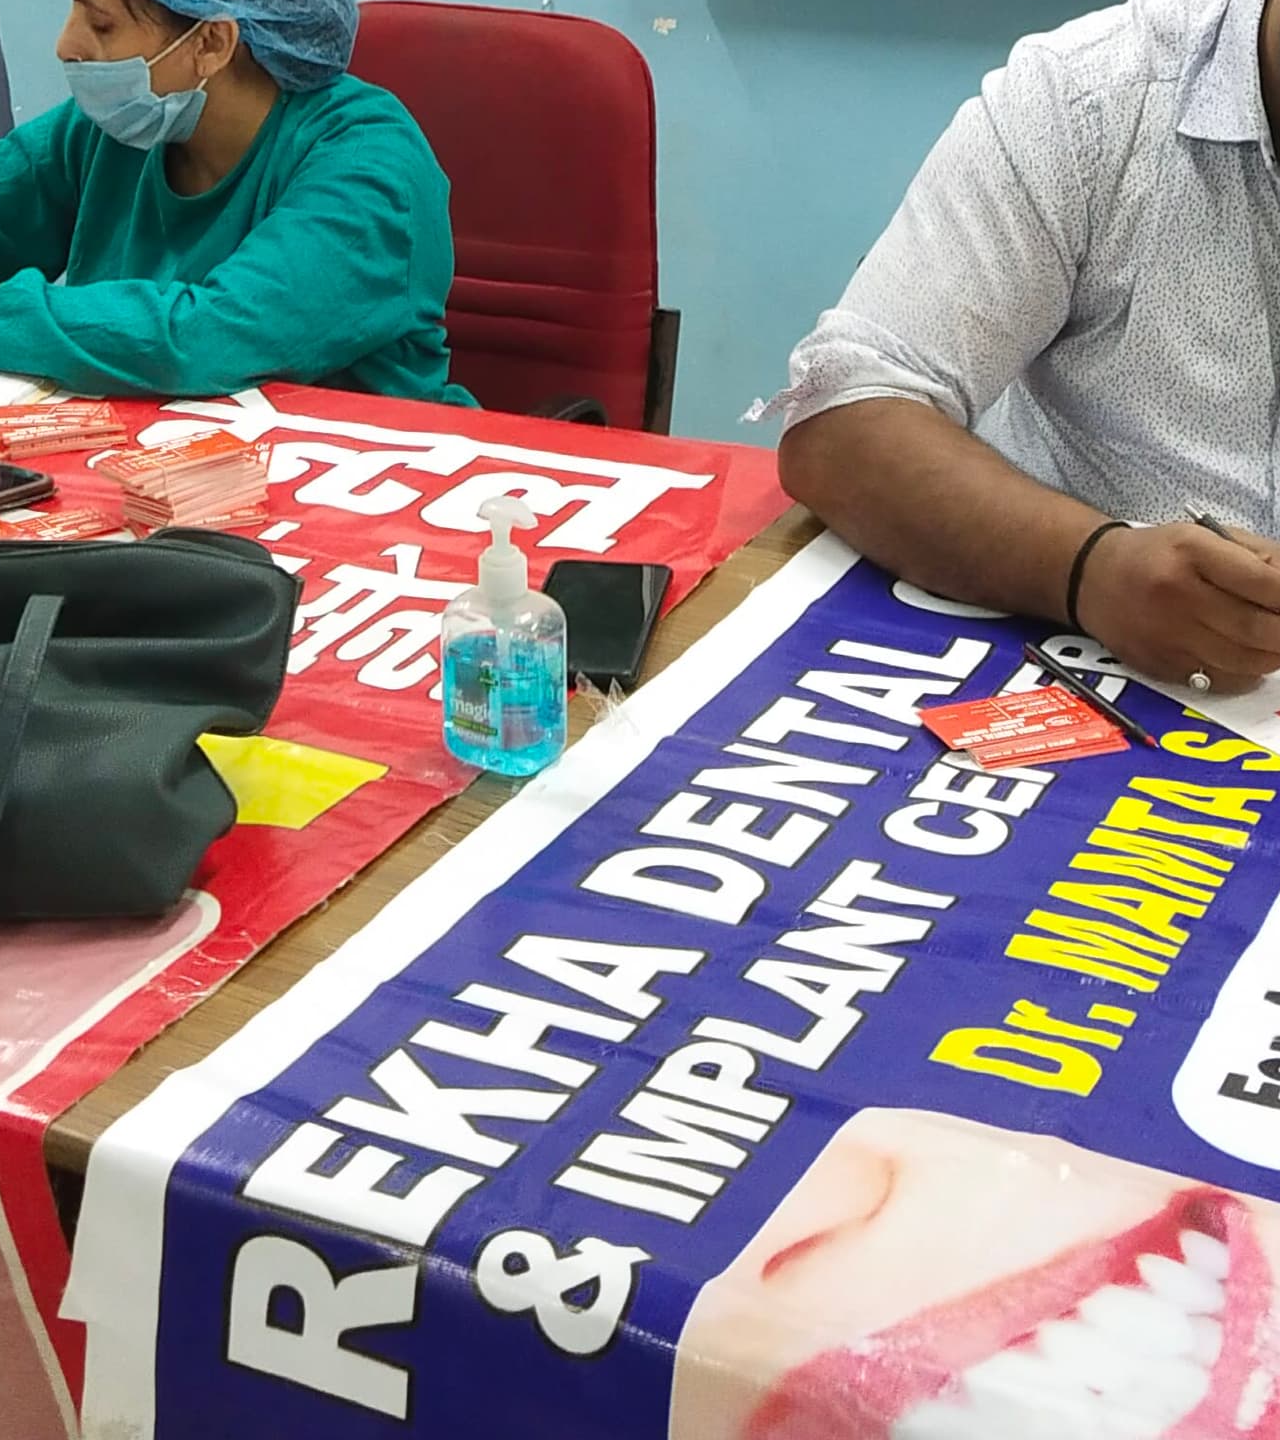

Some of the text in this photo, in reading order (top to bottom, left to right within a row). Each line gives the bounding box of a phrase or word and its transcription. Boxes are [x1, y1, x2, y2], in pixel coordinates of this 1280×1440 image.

[1005, 777, 1276, 991] MAMTA
[227, 636, 992, 1421] REKHA DENTAL
[553, 860, 958, 1223] IMPLANT
[928, 995, 1136, 1098] Dr.
[477, 1230, 652, 1355] &
